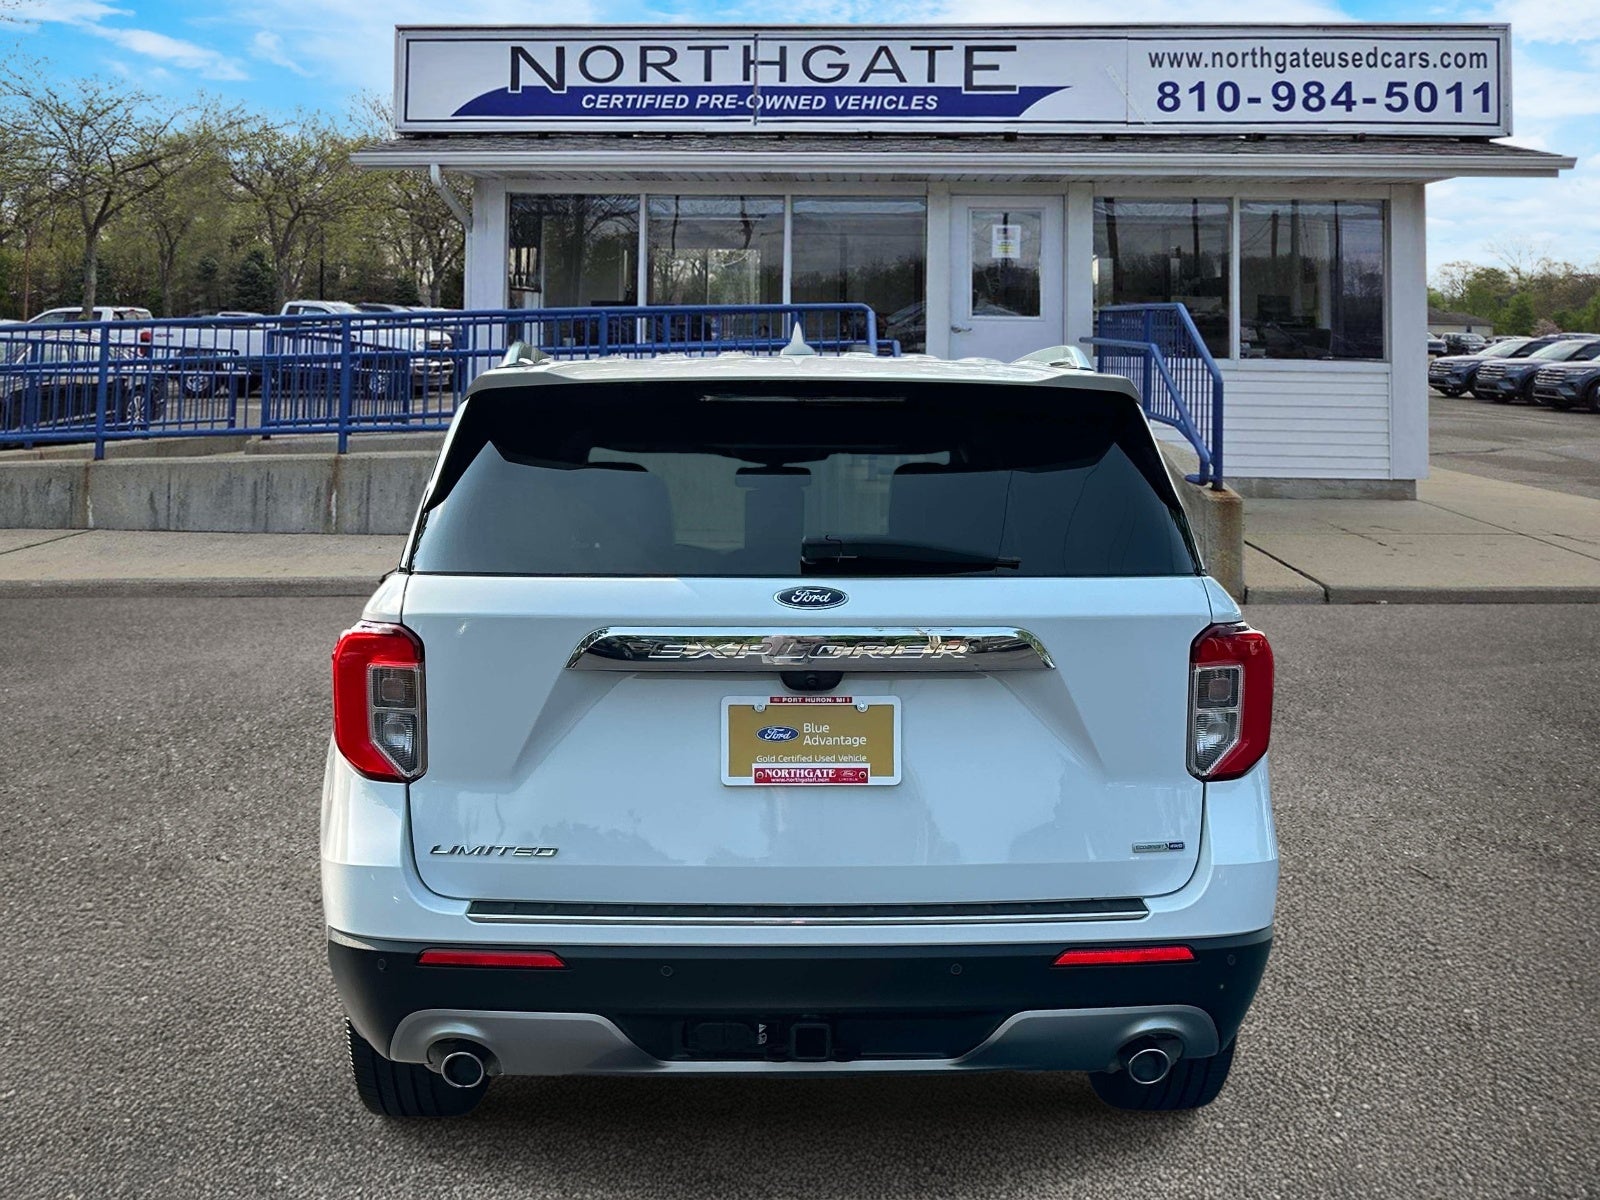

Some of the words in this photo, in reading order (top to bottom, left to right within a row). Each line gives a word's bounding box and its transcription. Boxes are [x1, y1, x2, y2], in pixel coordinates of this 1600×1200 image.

[1149, 48, 1489, 73] www.northgateusedcars.com
[510, 45, 1017, 92] NORTHGATE
[581, 94, 690, 109] CERTIFIED
[695, 95, 827, 110] PRE-OWNED
[834, 96, 939, 111] VEHICLES
[1156, 80, 1491, 113] 810-984-5011
[791, 589, 832, 603] Ford
[648, 642, 970, 660] EXPLORER
[764, 728, 792, 740] Ford
[803, 723, 829, 733] Blue
[803, 735, 867, 747] Advantage
[756, 755, 776, 763] Gold
[778, 754, 813, 763] Certified
[814, 754, 836, 763] Used
[838, 754, 867, 763] Vehicle
[764, 769, 836, 778] NORTHGATE
[430, 844, 559, 857] LIMITED
